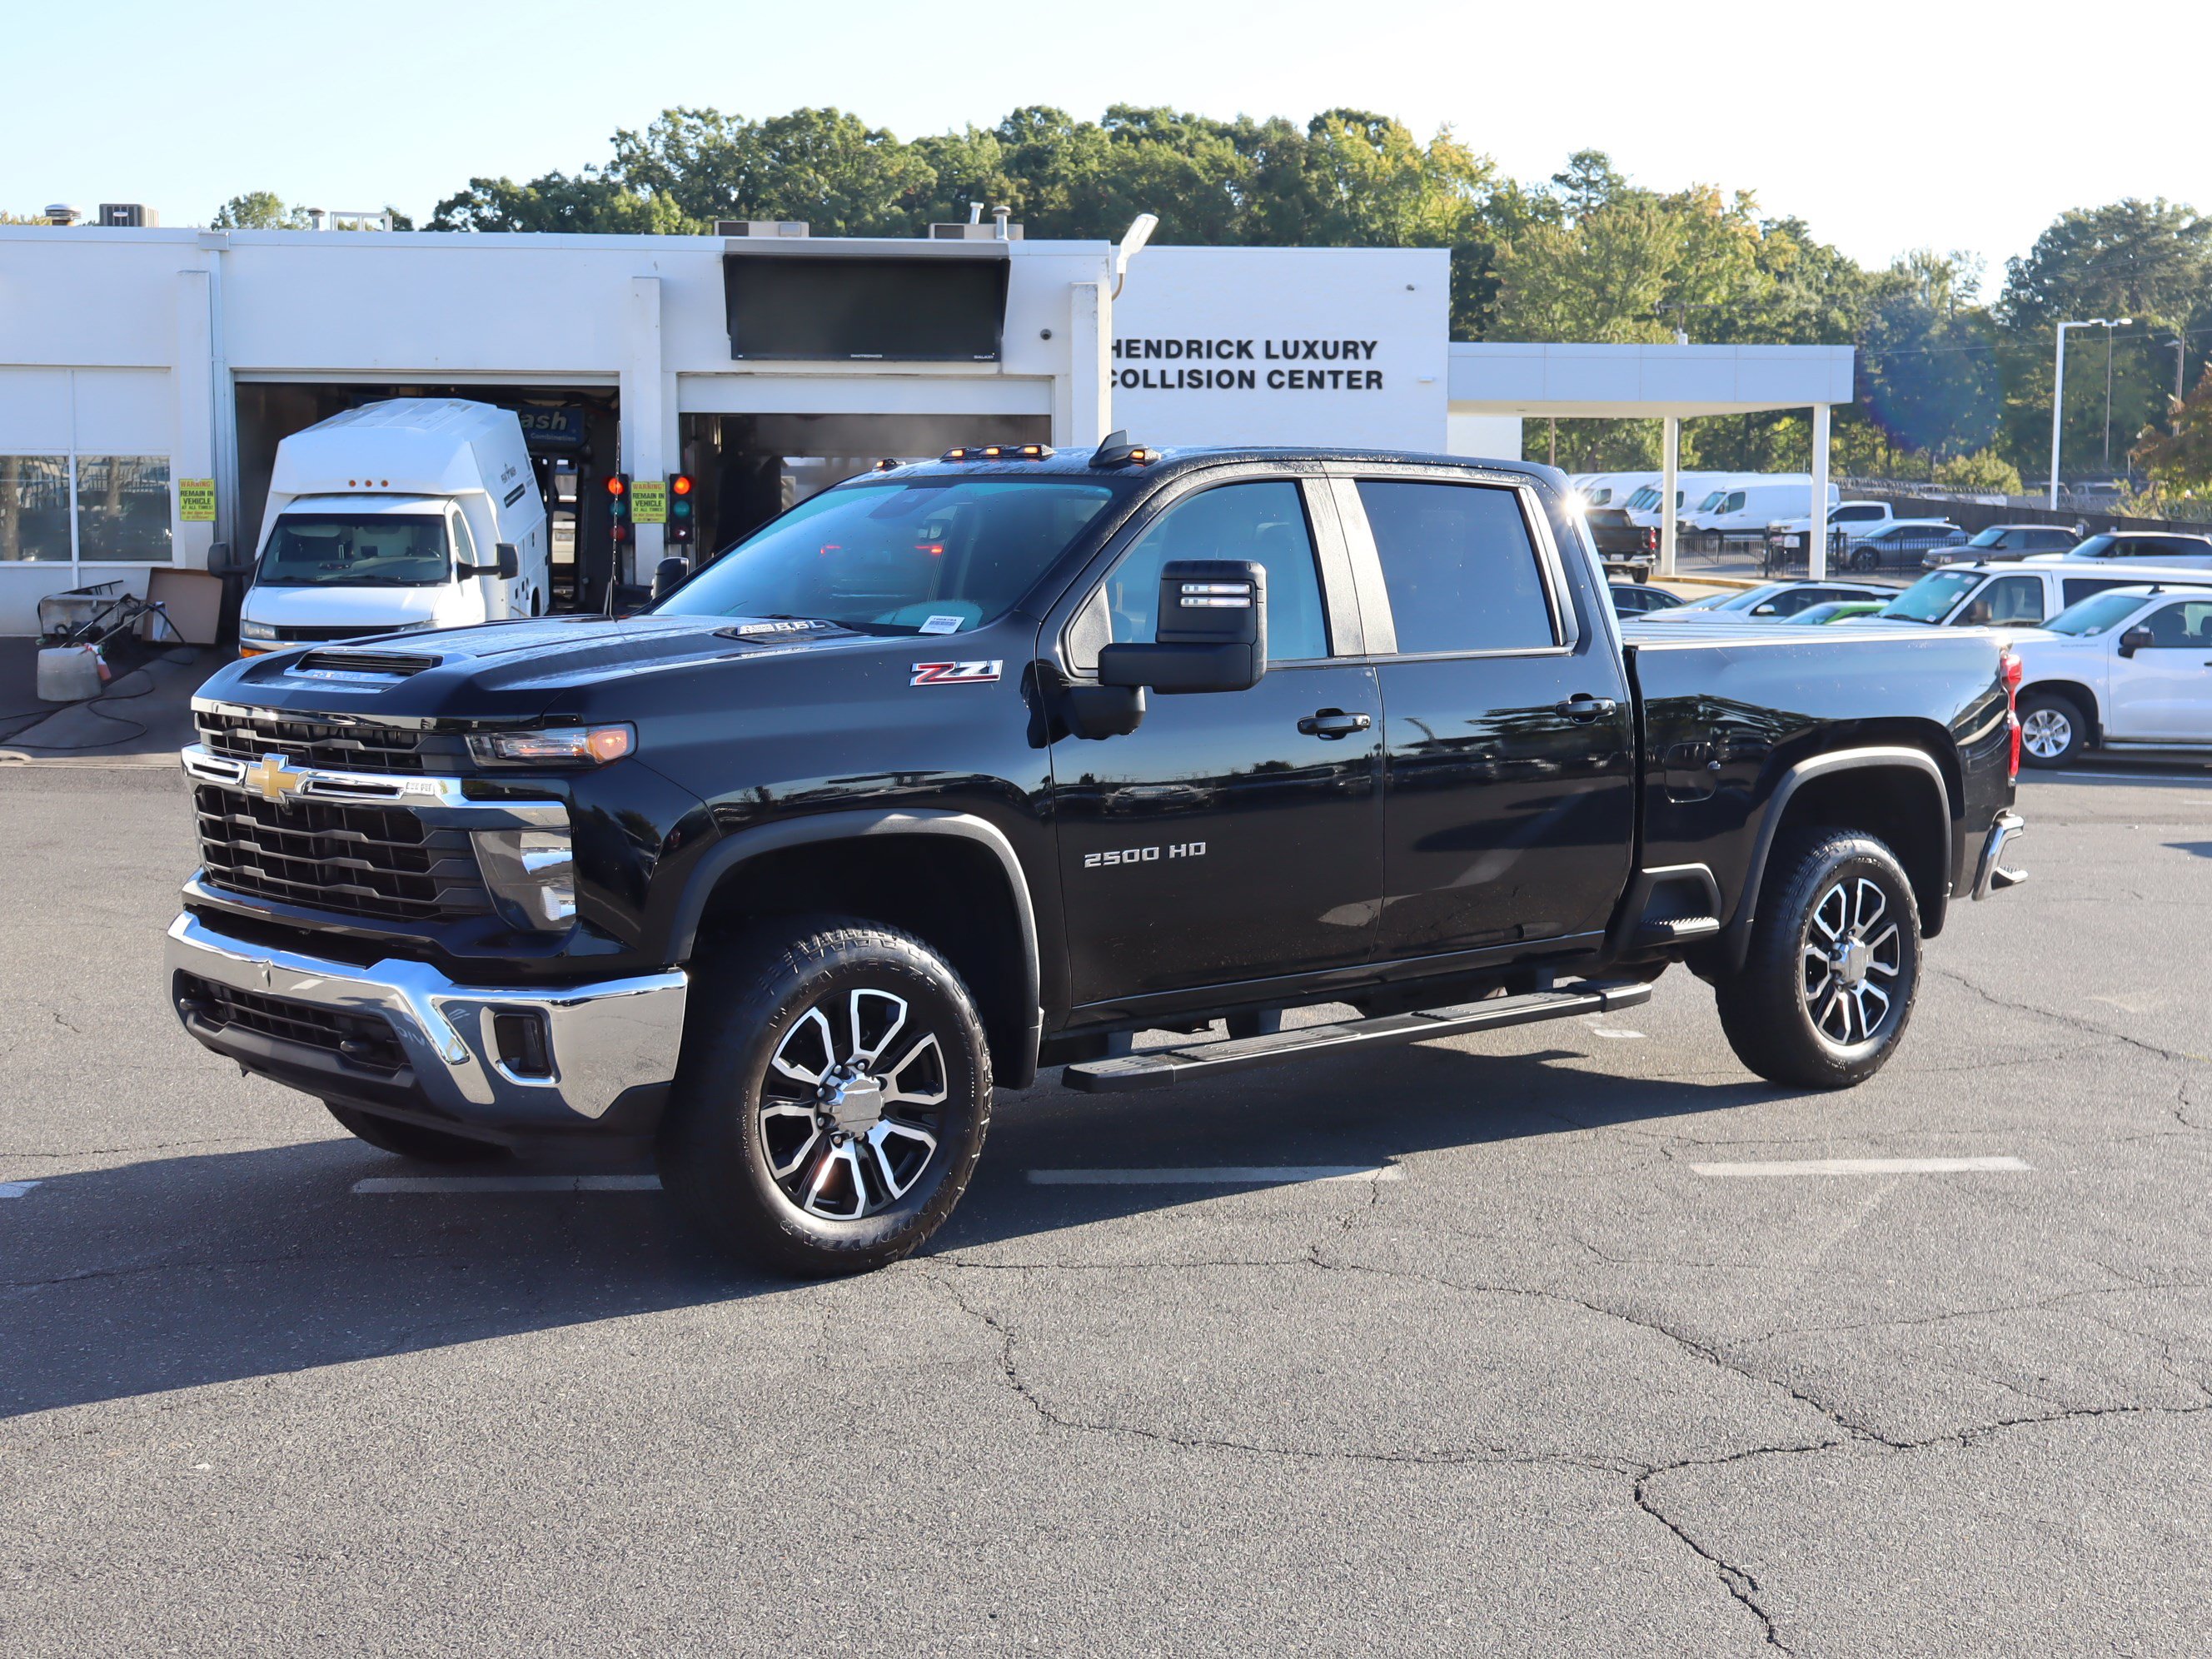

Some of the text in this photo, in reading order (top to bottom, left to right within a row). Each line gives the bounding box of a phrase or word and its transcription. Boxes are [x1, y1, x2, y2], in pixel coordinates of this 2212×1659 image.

[1264, 340, 1378, 360] LUXURY
[1267, 370, 1383, 390] CENTER
[517, 408, 567, 431] ash
[909, 660, 1004, 687] Z71
[1084, 841, 1207, 869] 2500 HD
